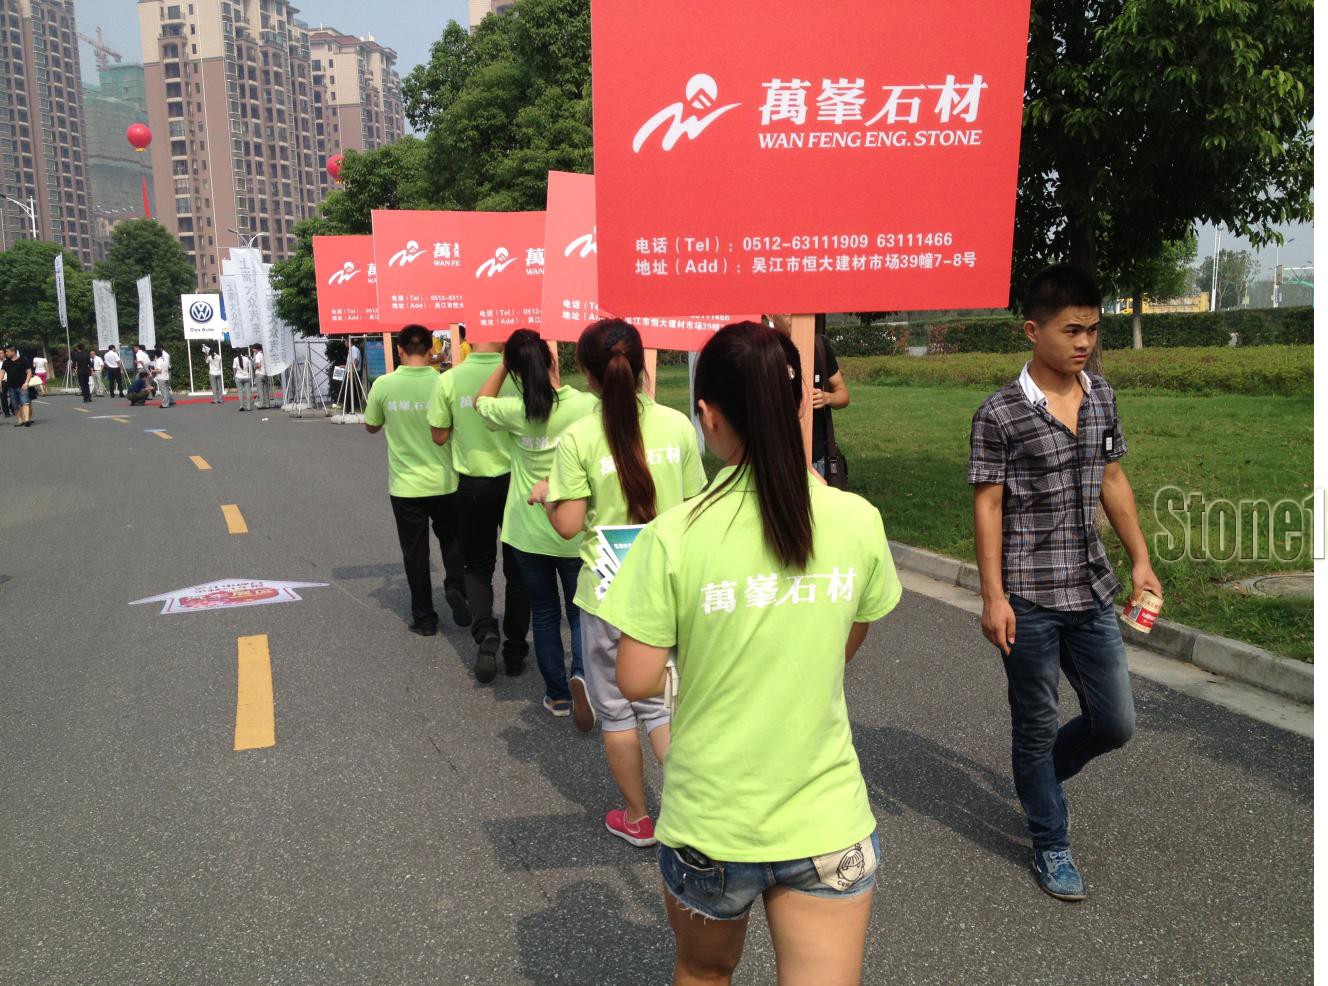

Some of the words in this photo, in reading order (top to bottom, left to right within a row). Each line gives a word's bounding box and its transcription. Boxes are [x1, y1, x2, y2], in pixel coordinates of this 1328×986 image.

[758, 74, 988, 127] 萬峯石材
[758, 132, 804, 149] WAN
[808, 131, 862, 148] FENG
[864, 131, 911, 147] ENG.
[914, 130, 983, 146] STONE
[877, 232, 953, 248] 63111466
